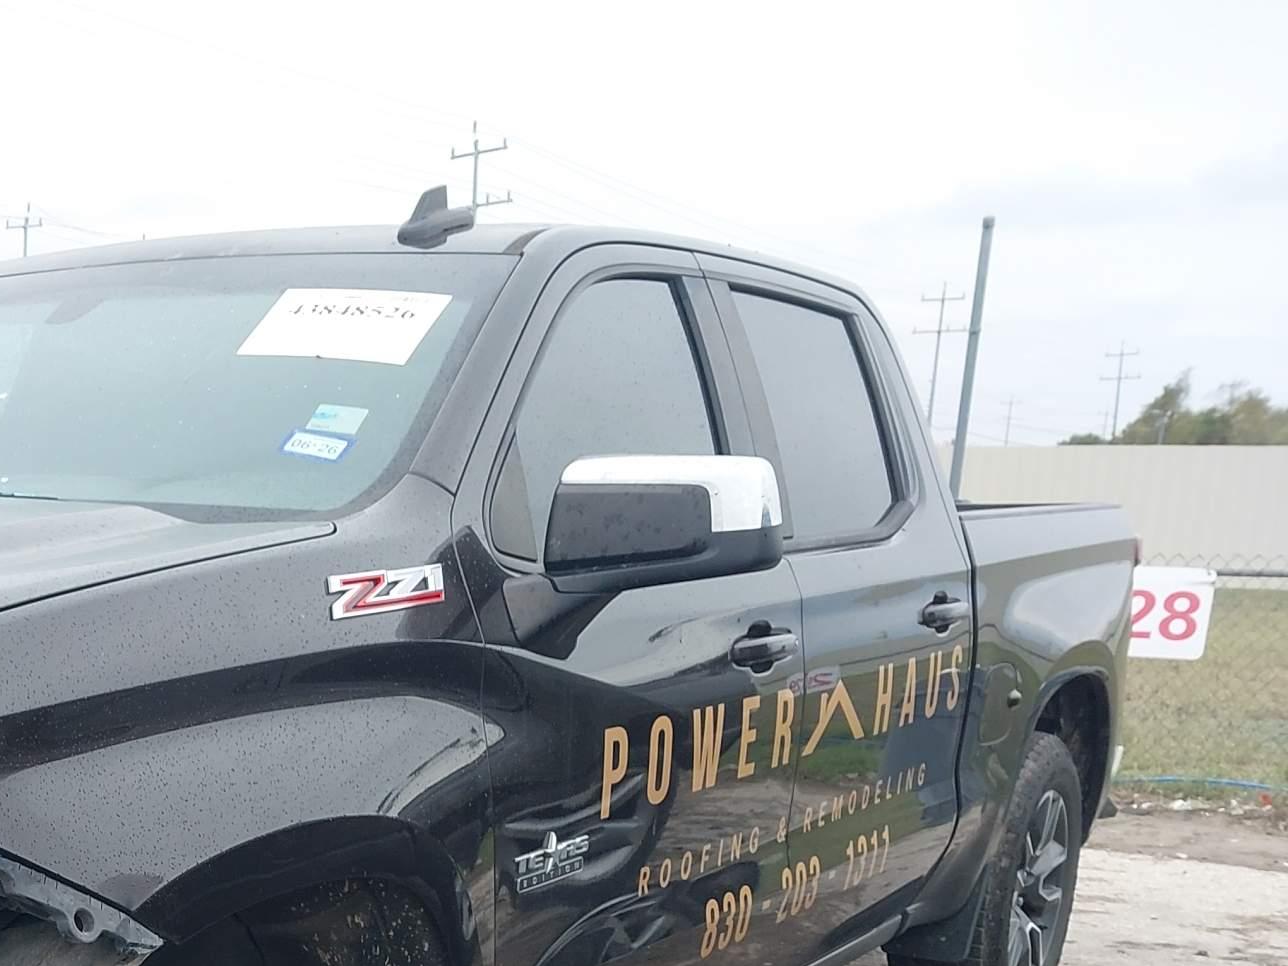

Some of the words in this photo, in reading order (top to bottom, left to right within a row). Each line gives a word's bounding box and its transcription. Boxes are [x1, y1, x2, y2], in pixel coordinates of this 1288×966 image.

[600, 688, 794, 820] POWER
[872, 644, 963, 737] HAUS
[515, 831, 589, 874] TEXAS
[638, 826, 760, 898] ROOFING
[775, 816, 788, 843] &
[802, 762, 927, 834] REMODELING
[700, 884, 753, 960] 830
